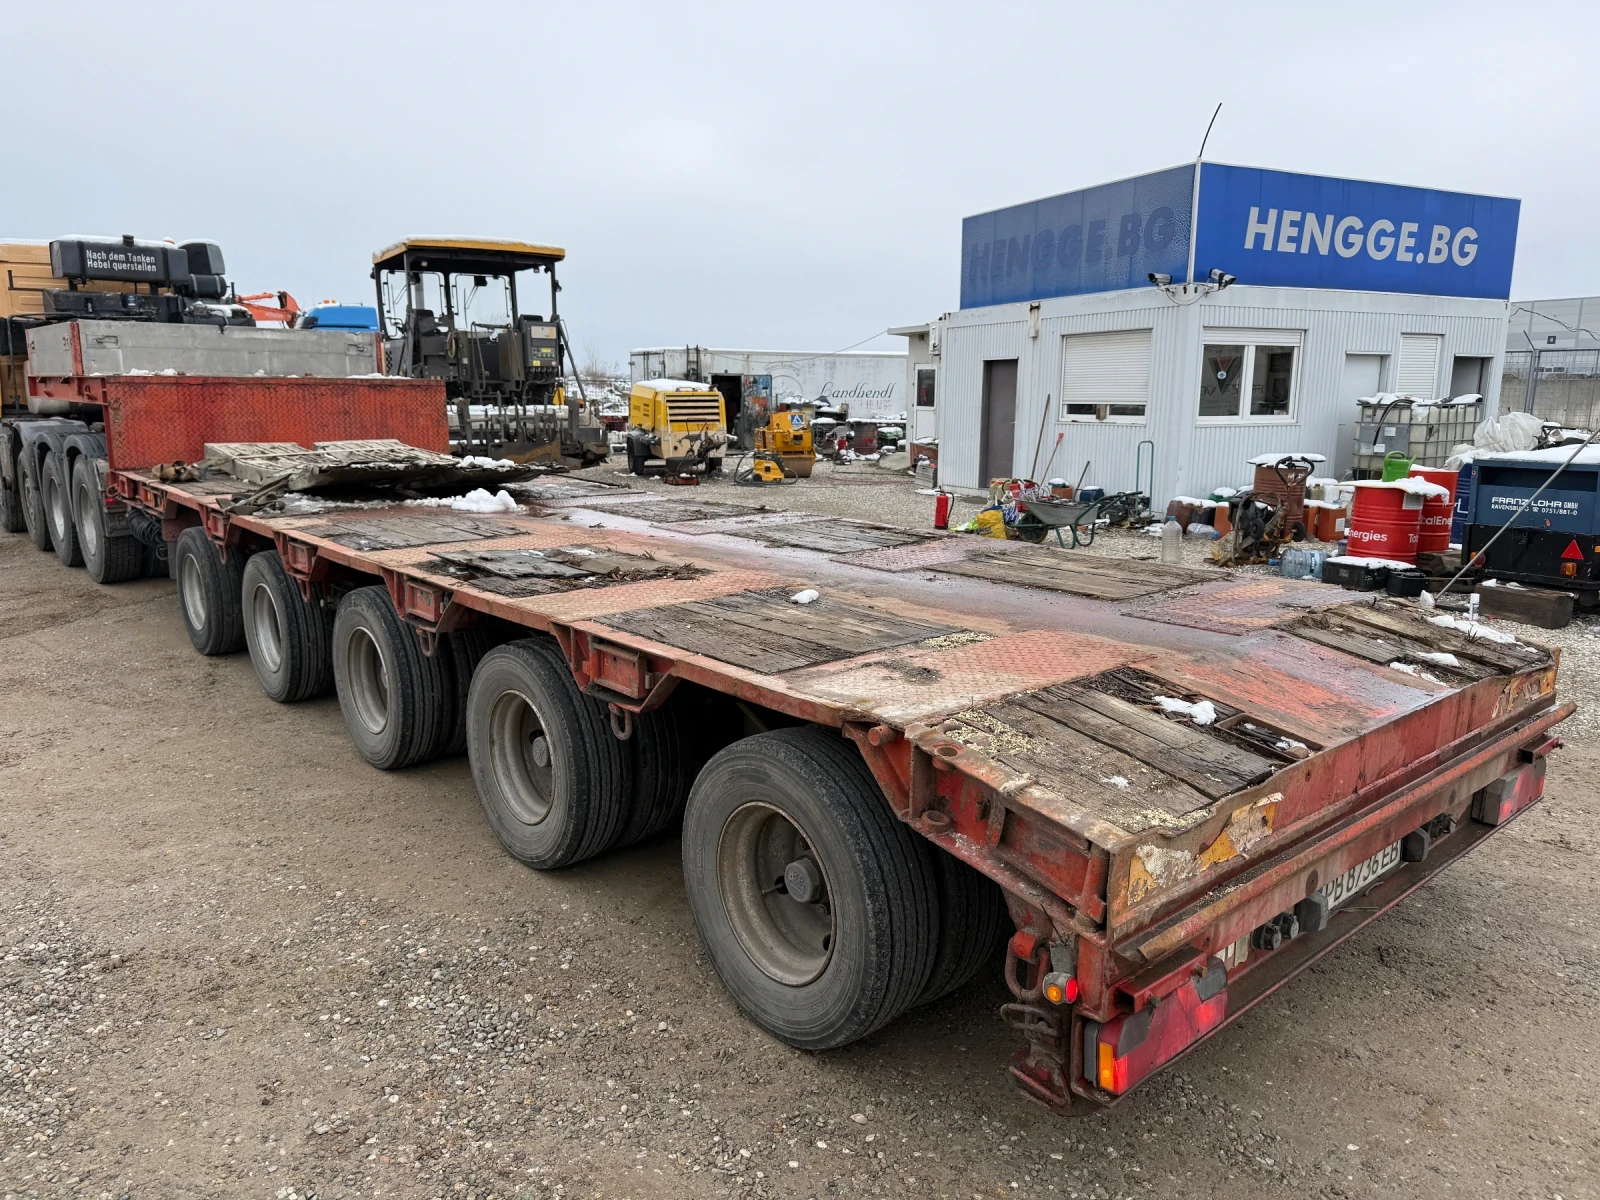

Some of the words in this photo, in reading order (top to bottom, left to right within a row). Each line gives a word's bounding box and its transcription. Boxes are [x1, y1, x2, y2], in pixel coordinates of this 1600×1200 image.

[969, 206, 1176, 281] HENGGE.BG
[1244, 206, 1479, 267] HENGGE.BG
[86, 249, 107, 260] Nach
[108, 252, 126, 261] dem
[127, 252, 156, 264] Tanken
[87, 258, 111, 269] Hebel
[112, 261, 157, 272] querstellen
[820, 381, 897, 399] Landhendl
[1491, 496, 1530, 506] FRANZ
[1531, 499, 1562, 508] LOHR
[1563, 501, 1579, 510] GMBH
[1491, 503, 1530, 512] RAVENSBUG
[1541, 507, 1578, 516] 0751/881-0
[1347, 528, 1388, 543] nergies
